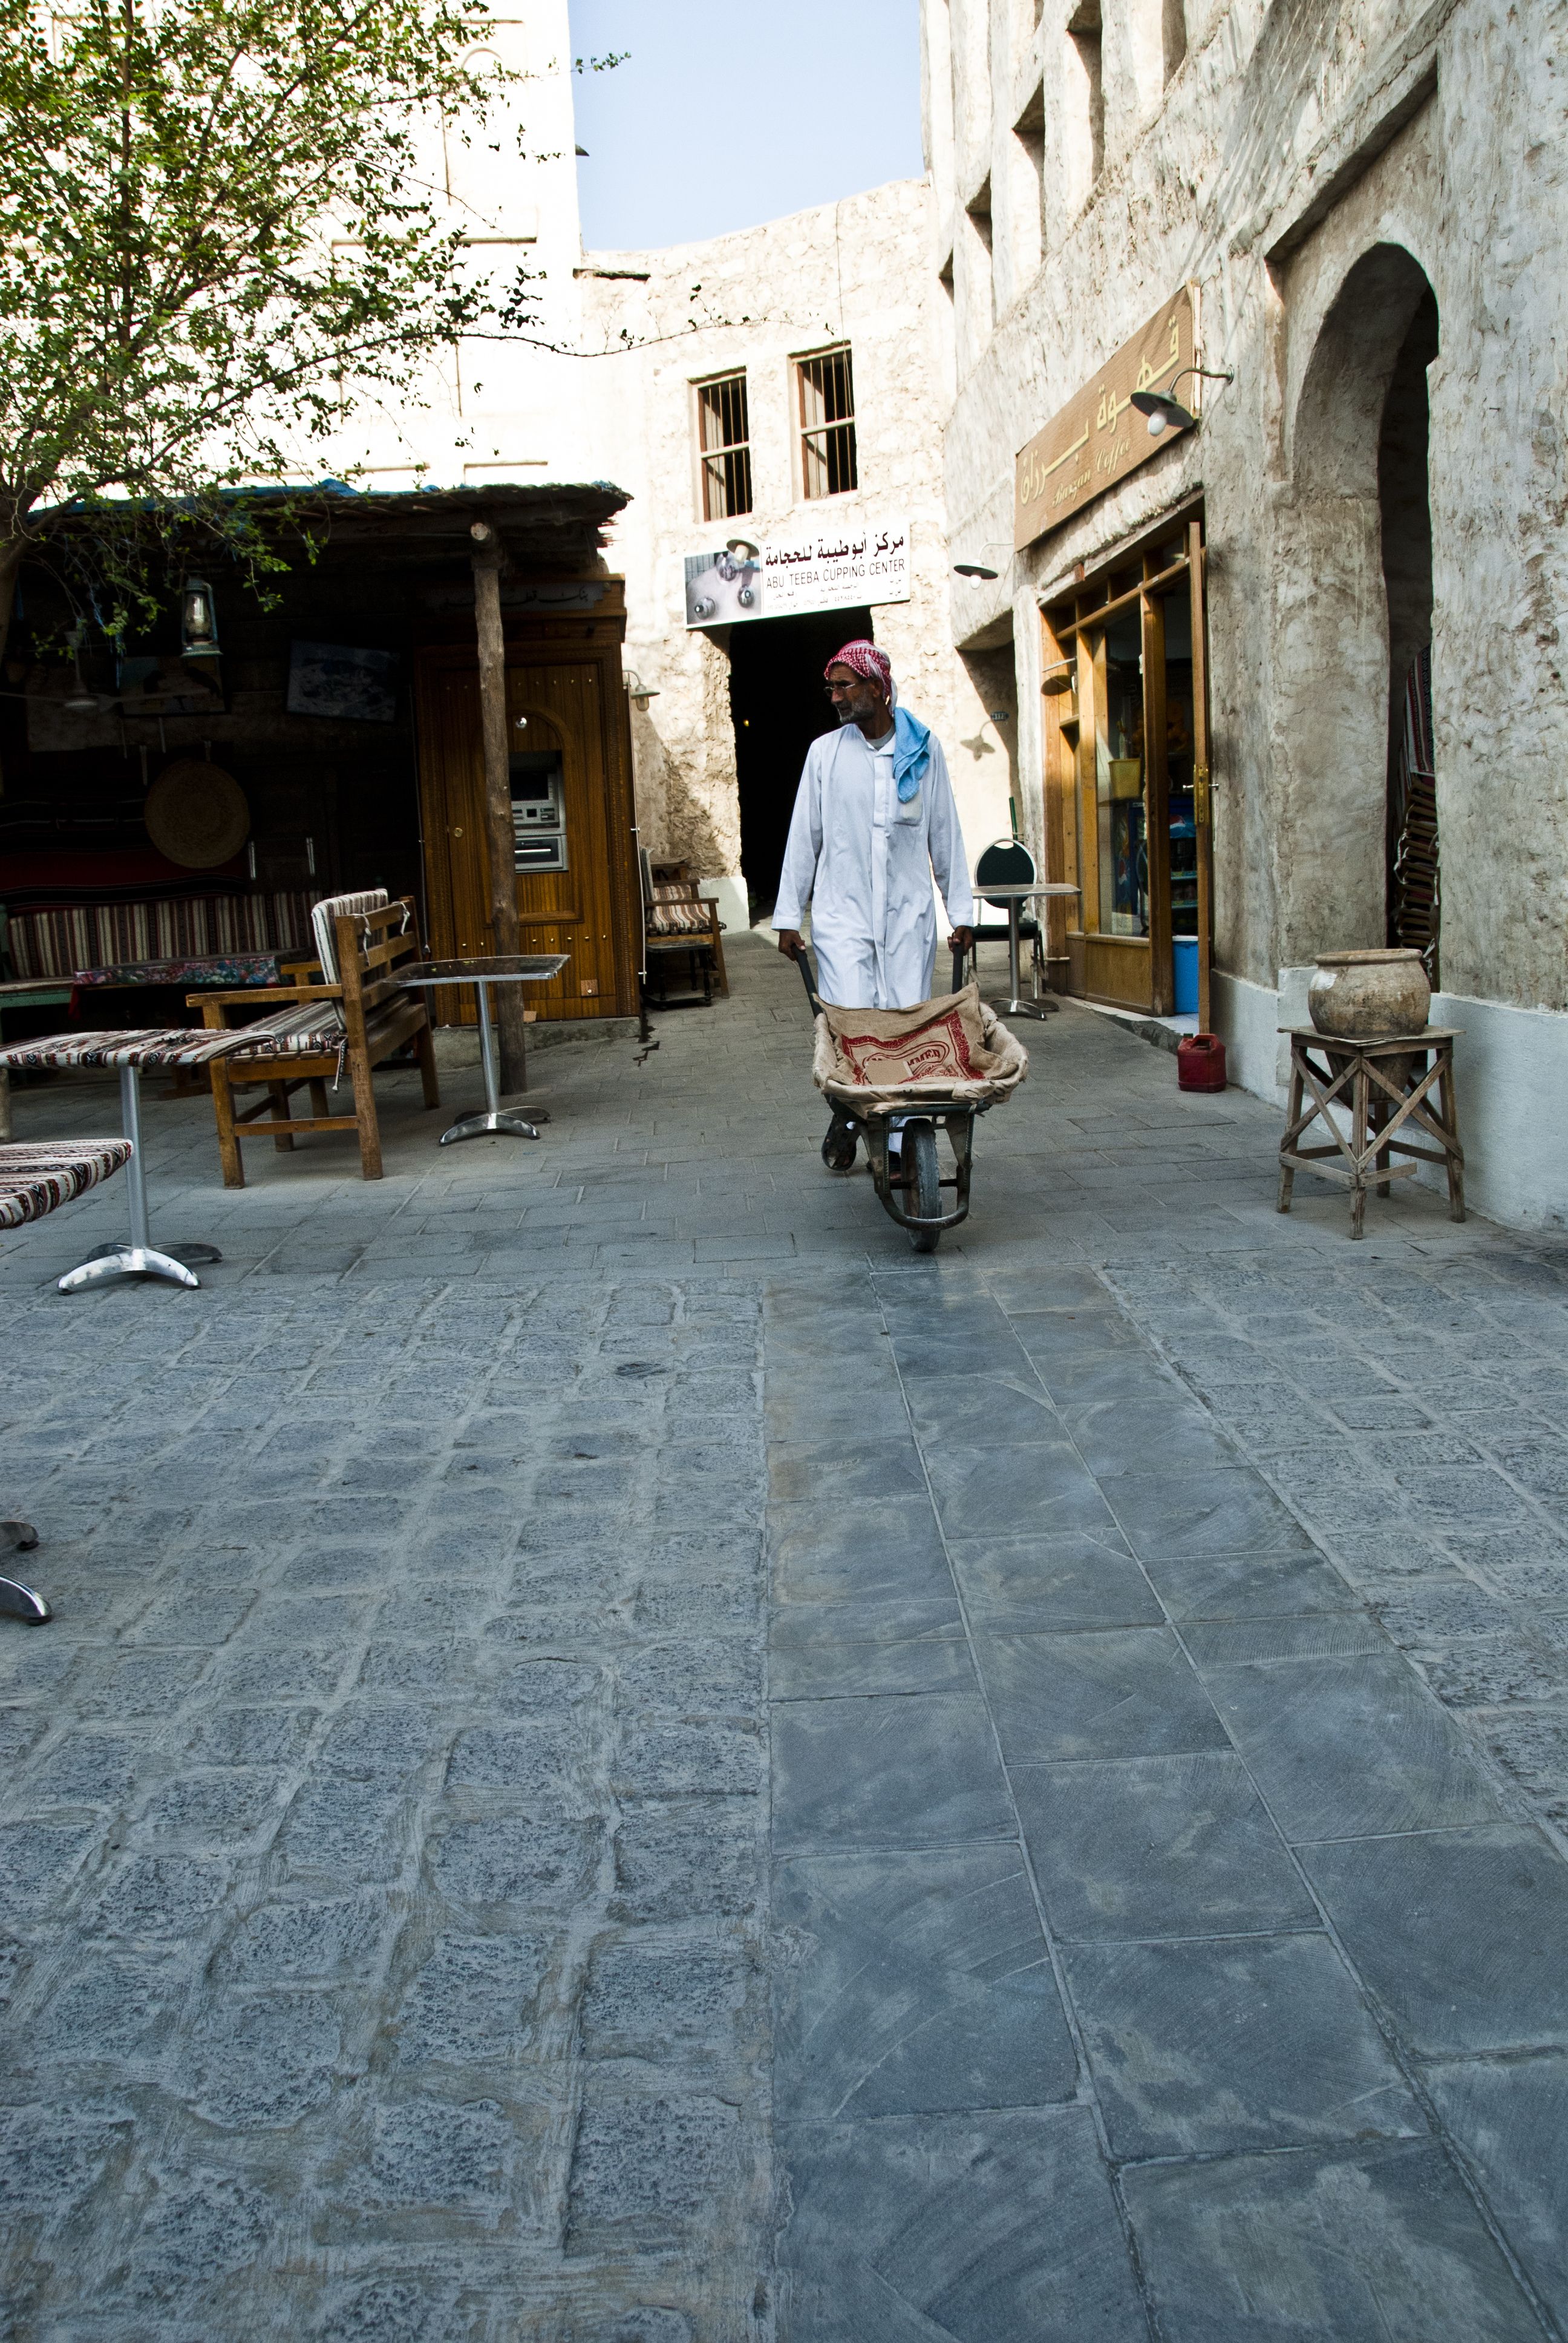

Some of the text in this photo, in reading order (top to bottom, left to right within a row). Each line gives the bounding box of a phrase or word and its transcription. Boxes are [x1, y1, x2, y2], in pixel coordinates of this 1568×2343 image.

[1096, 434, 1131, 476] Coffee
[765, 545, 812, 569] للحجامة
[873, 531, 904, 557] مركز
[766, 559, 905, 589] ABU TEEBA CUPPING CENTER
